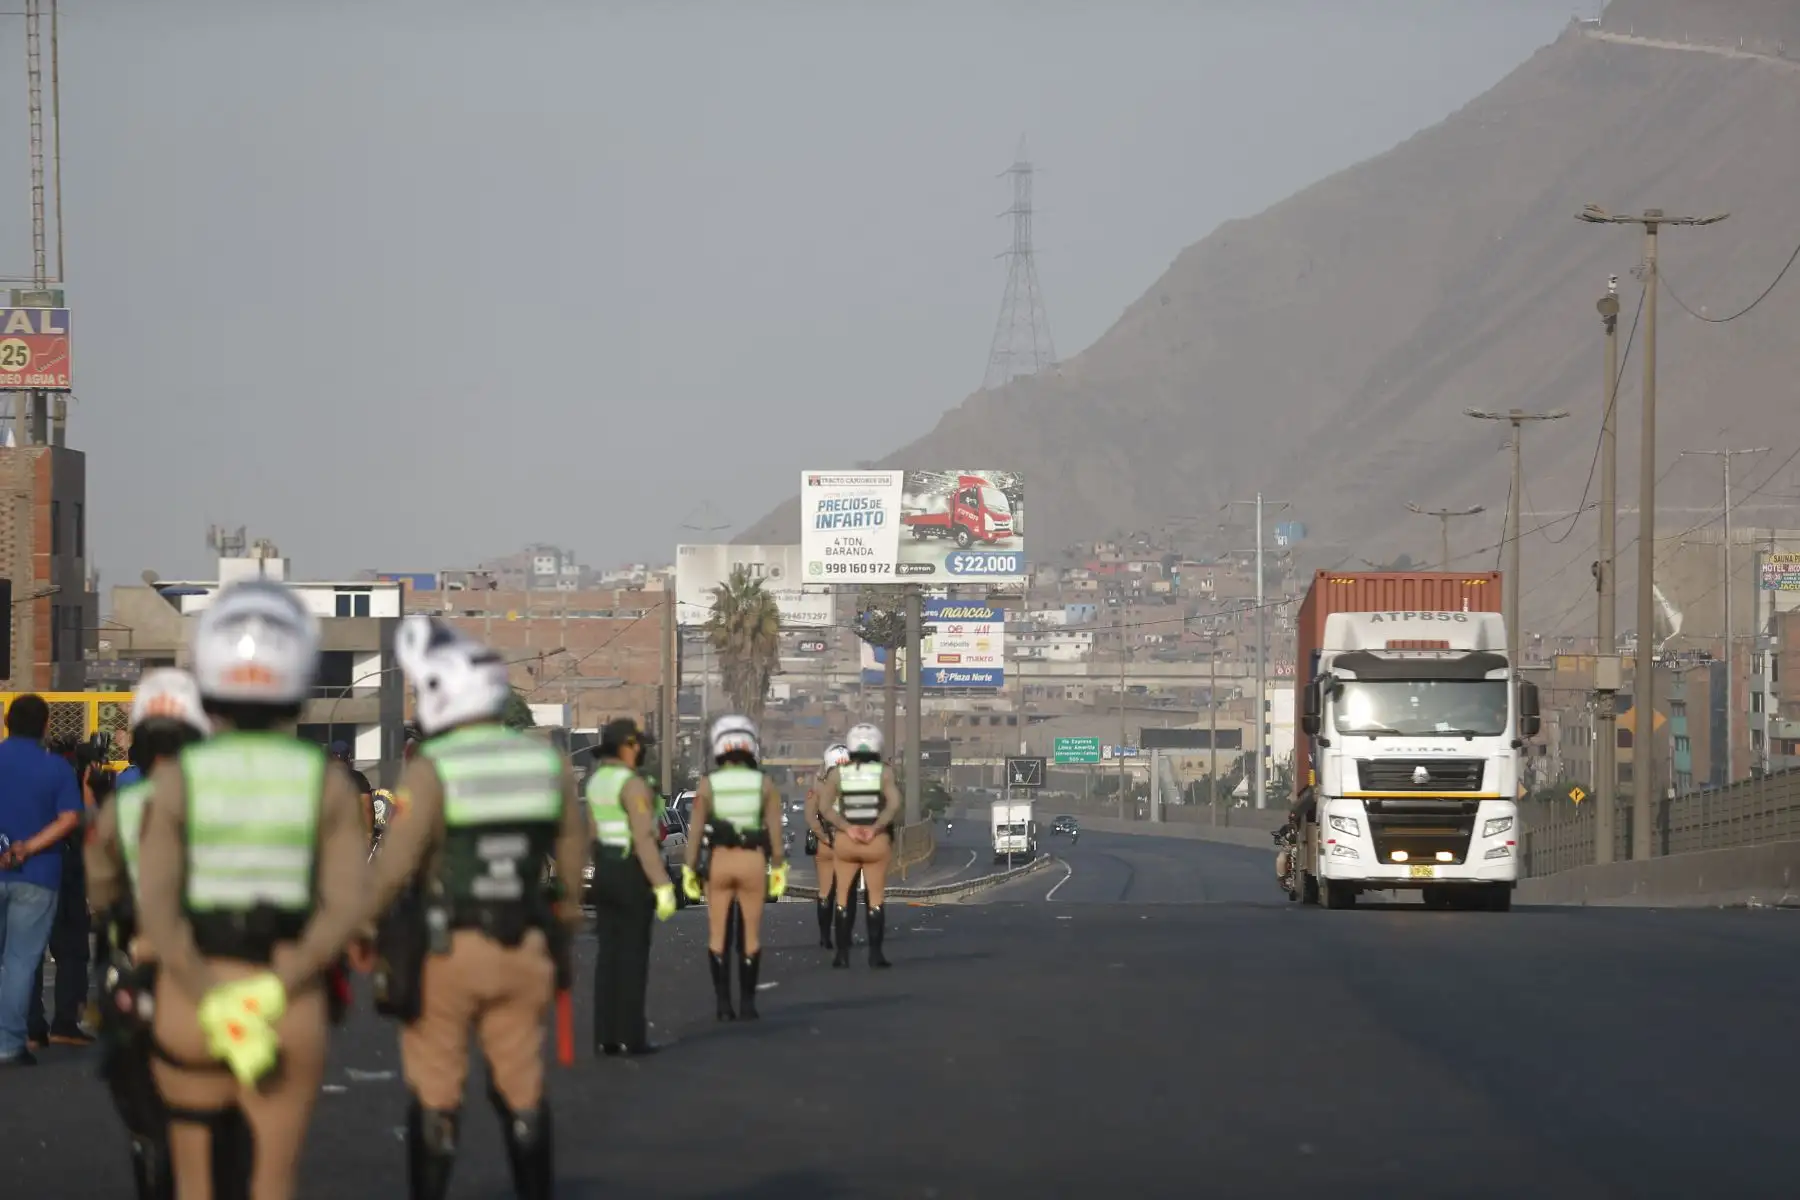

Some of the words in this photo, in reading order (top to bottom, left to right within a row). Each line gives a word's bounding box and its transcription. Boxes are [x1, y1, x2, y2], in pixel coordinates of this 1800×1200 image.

[0, 310, 65, 334] AL
[2, 344, 28, 367] 25
[24, 373, 56, 384] AGUA
[818, 497, 869, 512] PRECIOS
[869, 499, 882, 509] DE
[816, 511, 884, 529] INFARTO
[834, 537, 840, 546] 4
[825, 547, 874, 556] BARANDA
[825, 563, 847, 573] 998
[849, 563, 867, 573] 160
[869, 563, 890, 573] 972
[954, 556, 1016, 573] $22,000
[1762, 564, 1785, 572] HOTEL
[940, 607, 994, 618] marcas
[1370, 612, 1468, 623] ATP856
[966, 655, 994, 663] makro
[949, 672, 971, 681] Plaza
[971, 673, 993, 682] Norte
